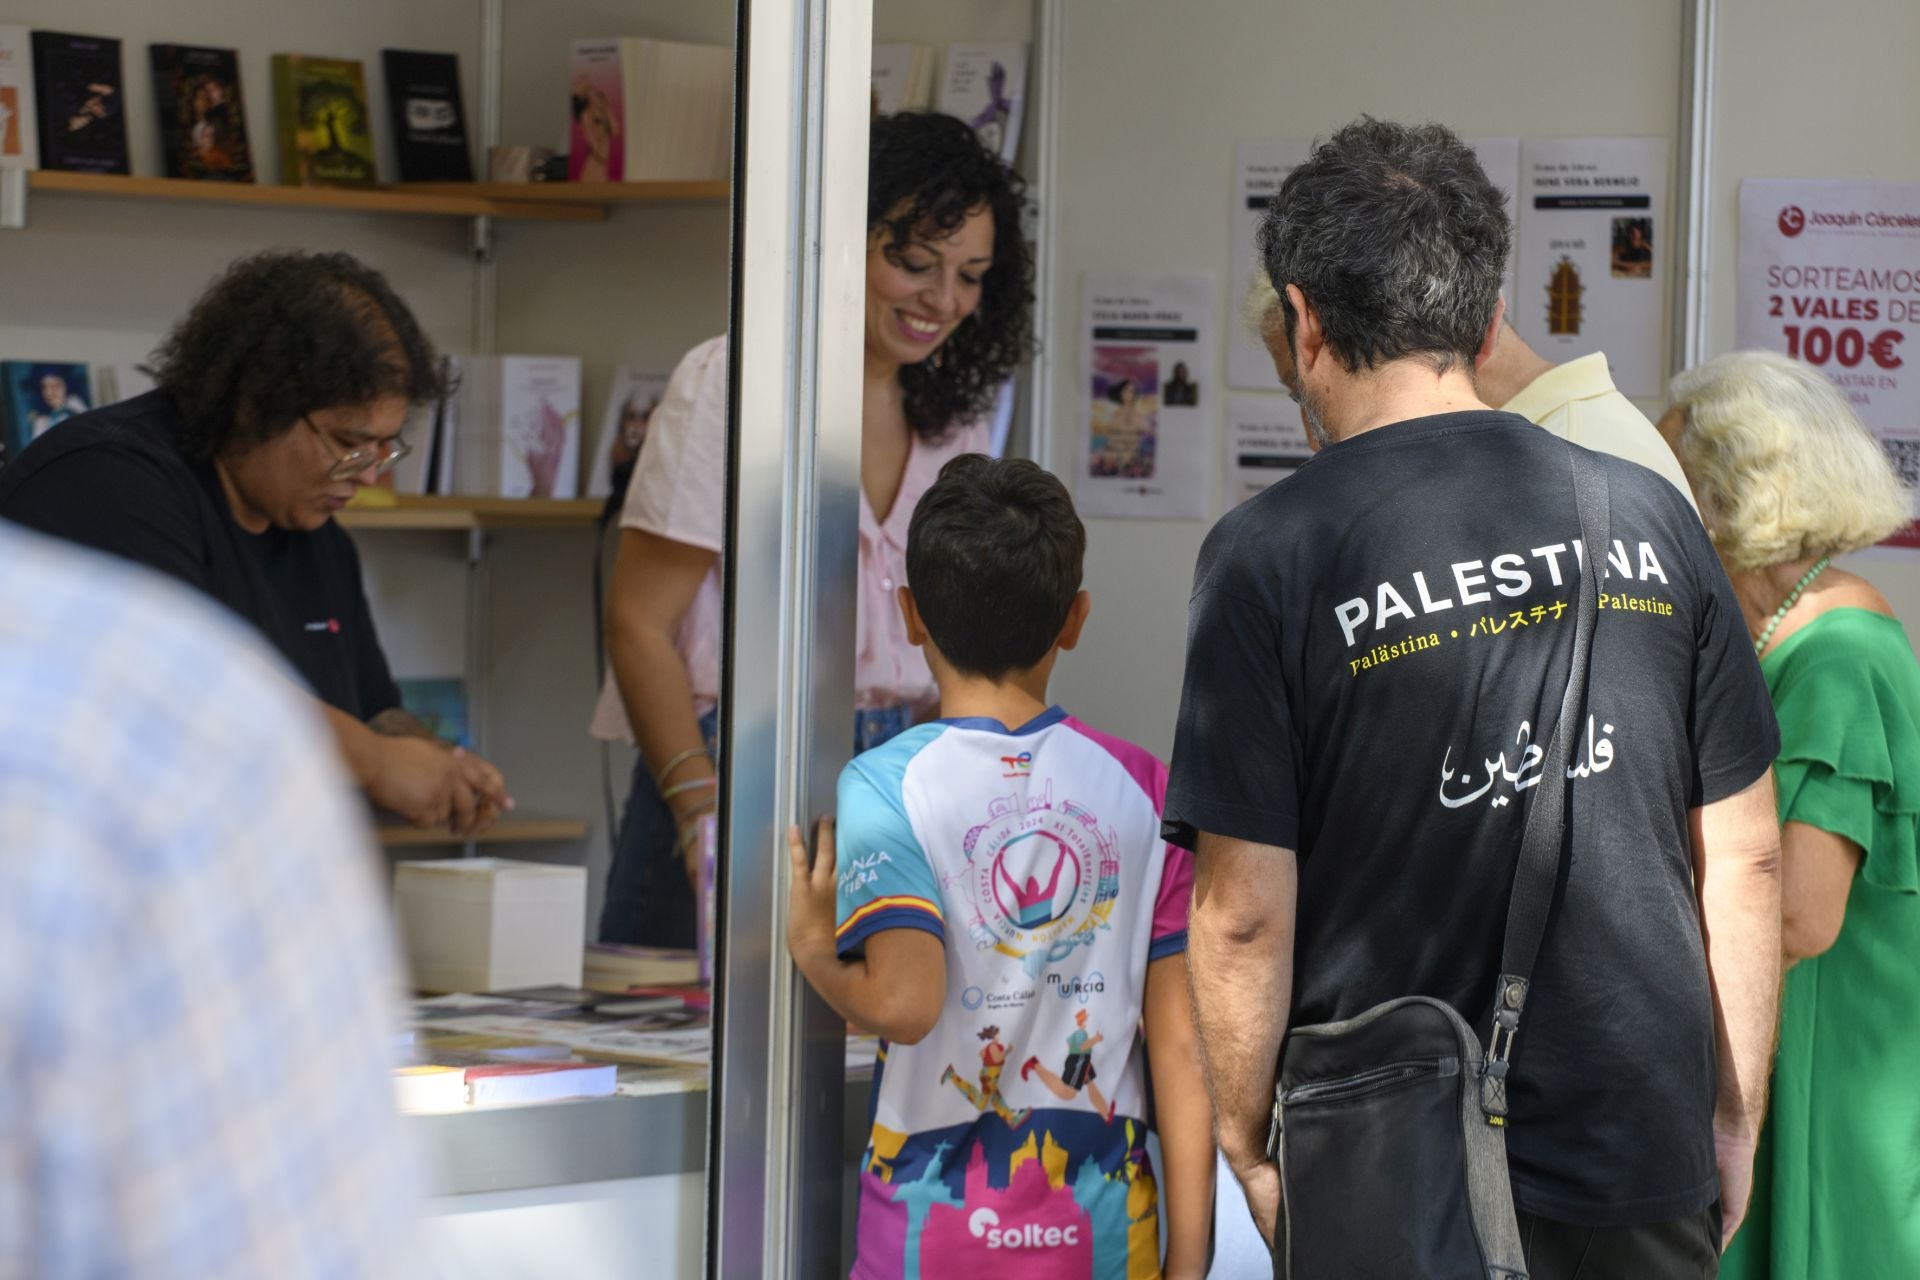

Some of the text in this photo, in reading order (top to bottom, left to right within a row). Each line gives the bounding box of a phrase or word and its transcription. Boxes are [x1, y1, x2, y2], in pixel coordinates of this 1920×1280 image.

[1768, 295, 1920, 324] 2 VALES DE
[1783, 326, 1905, 371] 100€
[1878, 375, 1897, 389] EN
[1469, 600, 1568, 637] パレスチナ
[1597, 593, 1673, 616] Palestine
[1349, 633, 1441, 677] Palästina
[980, 867, 993, 904] COSTA
[986, 1223, 1079, 1249] soltec
